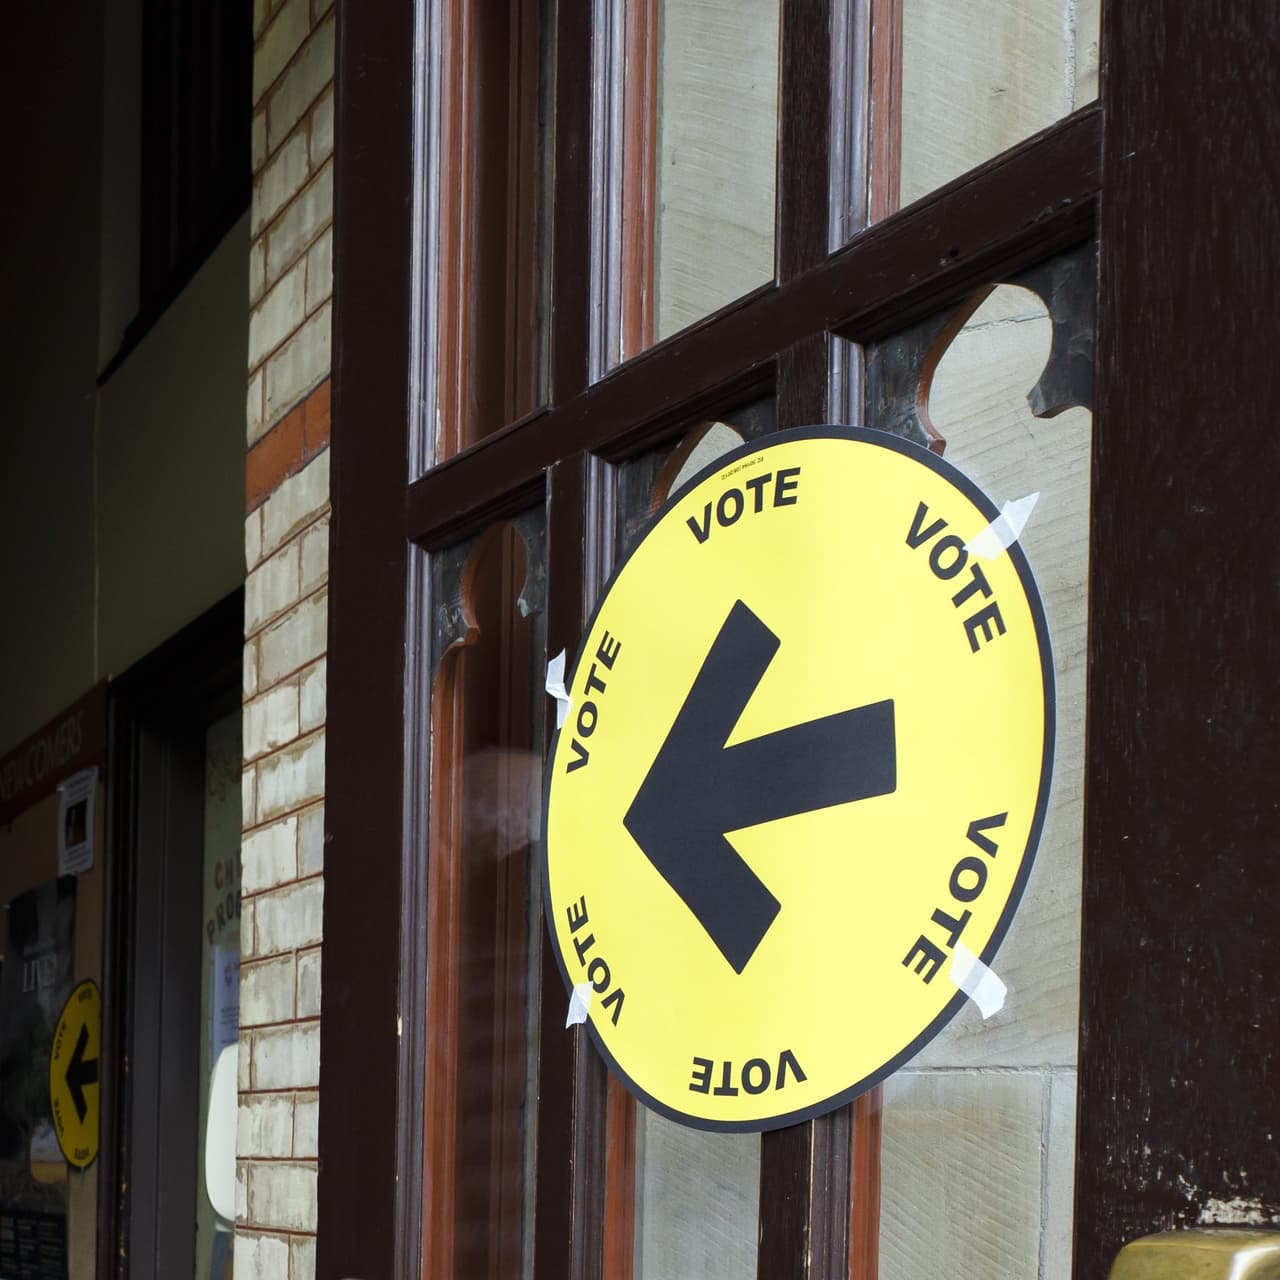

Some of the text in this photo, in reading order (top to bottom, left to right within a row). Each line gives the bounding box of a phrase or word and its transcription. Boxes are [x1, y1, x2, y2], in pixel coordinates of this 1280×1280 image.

[687, 468, 800, 544] VOTE
[907, 502, 1005, 652] VOTE
[567, 631, 621, 773] VOTE
[567, 896, 624, 1026] VOTE
[903, 813, 1007, 984] VOTE
[690, 1050, 807, 1096] VOTE
